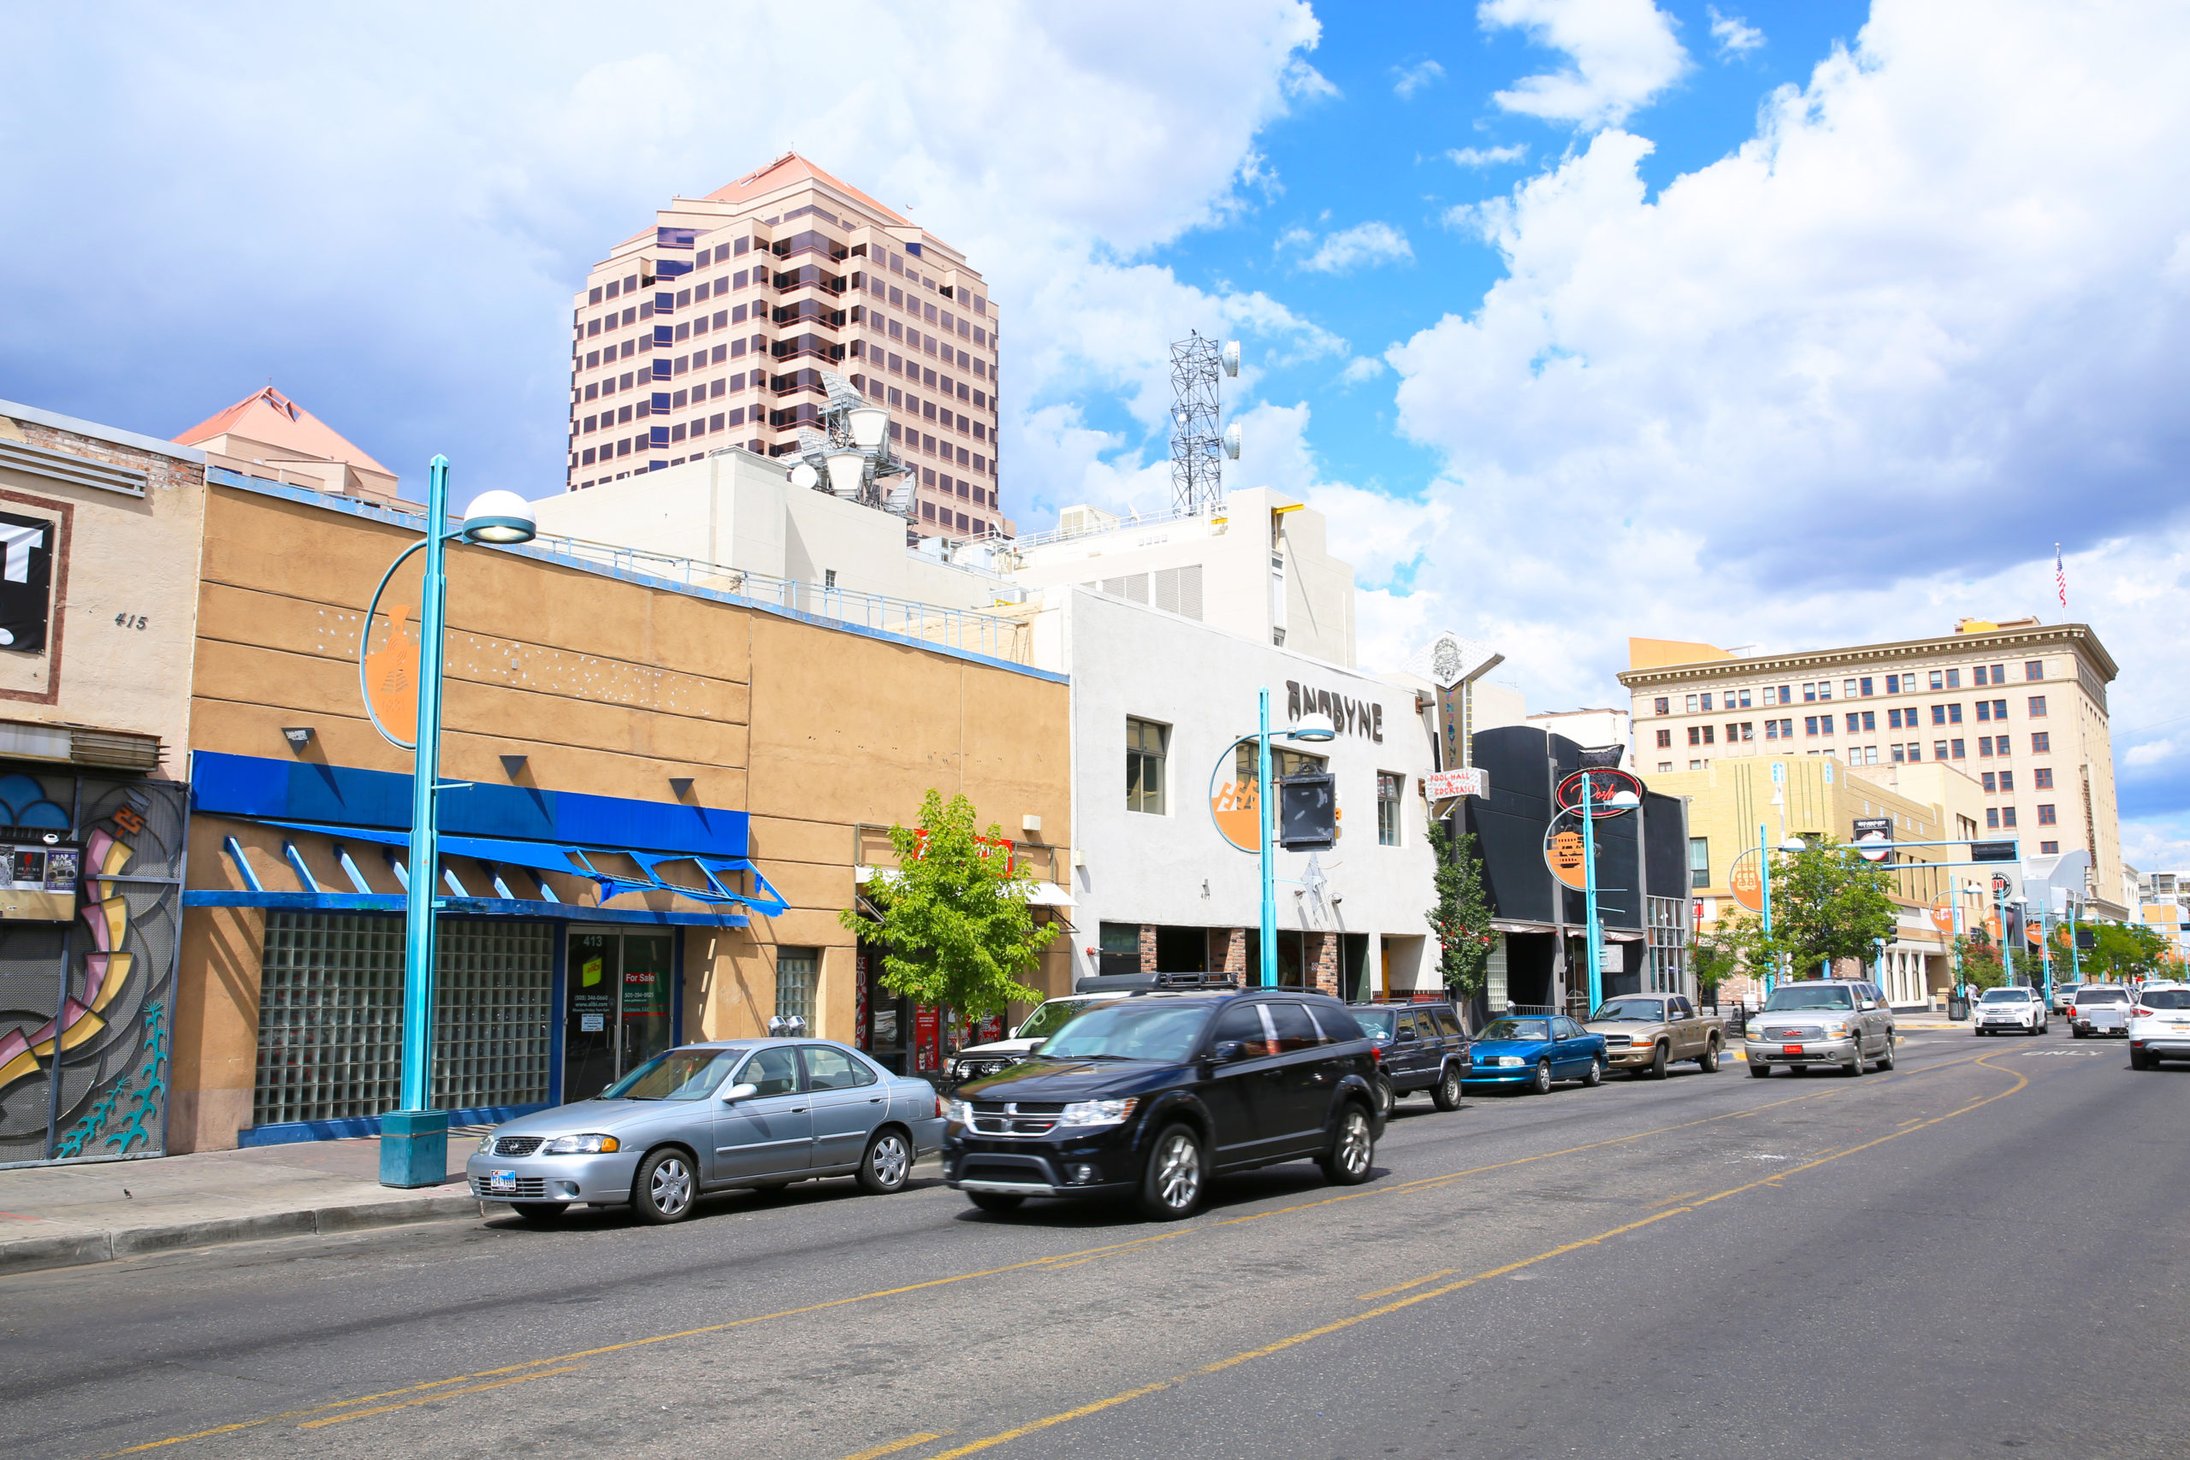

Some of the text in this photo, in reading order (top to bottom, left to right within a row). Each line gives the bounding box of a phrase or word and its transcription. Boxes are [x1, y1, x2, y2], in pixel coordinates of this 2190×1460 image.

[114, 613, 149, 631] 415
[1286, 680, 1384, 743] ANODYNE
[1429, 771, 1471, 783] POOL HALL
[583, 935, 602, 947] 413
[625, 973, 655, 982] For Sale
